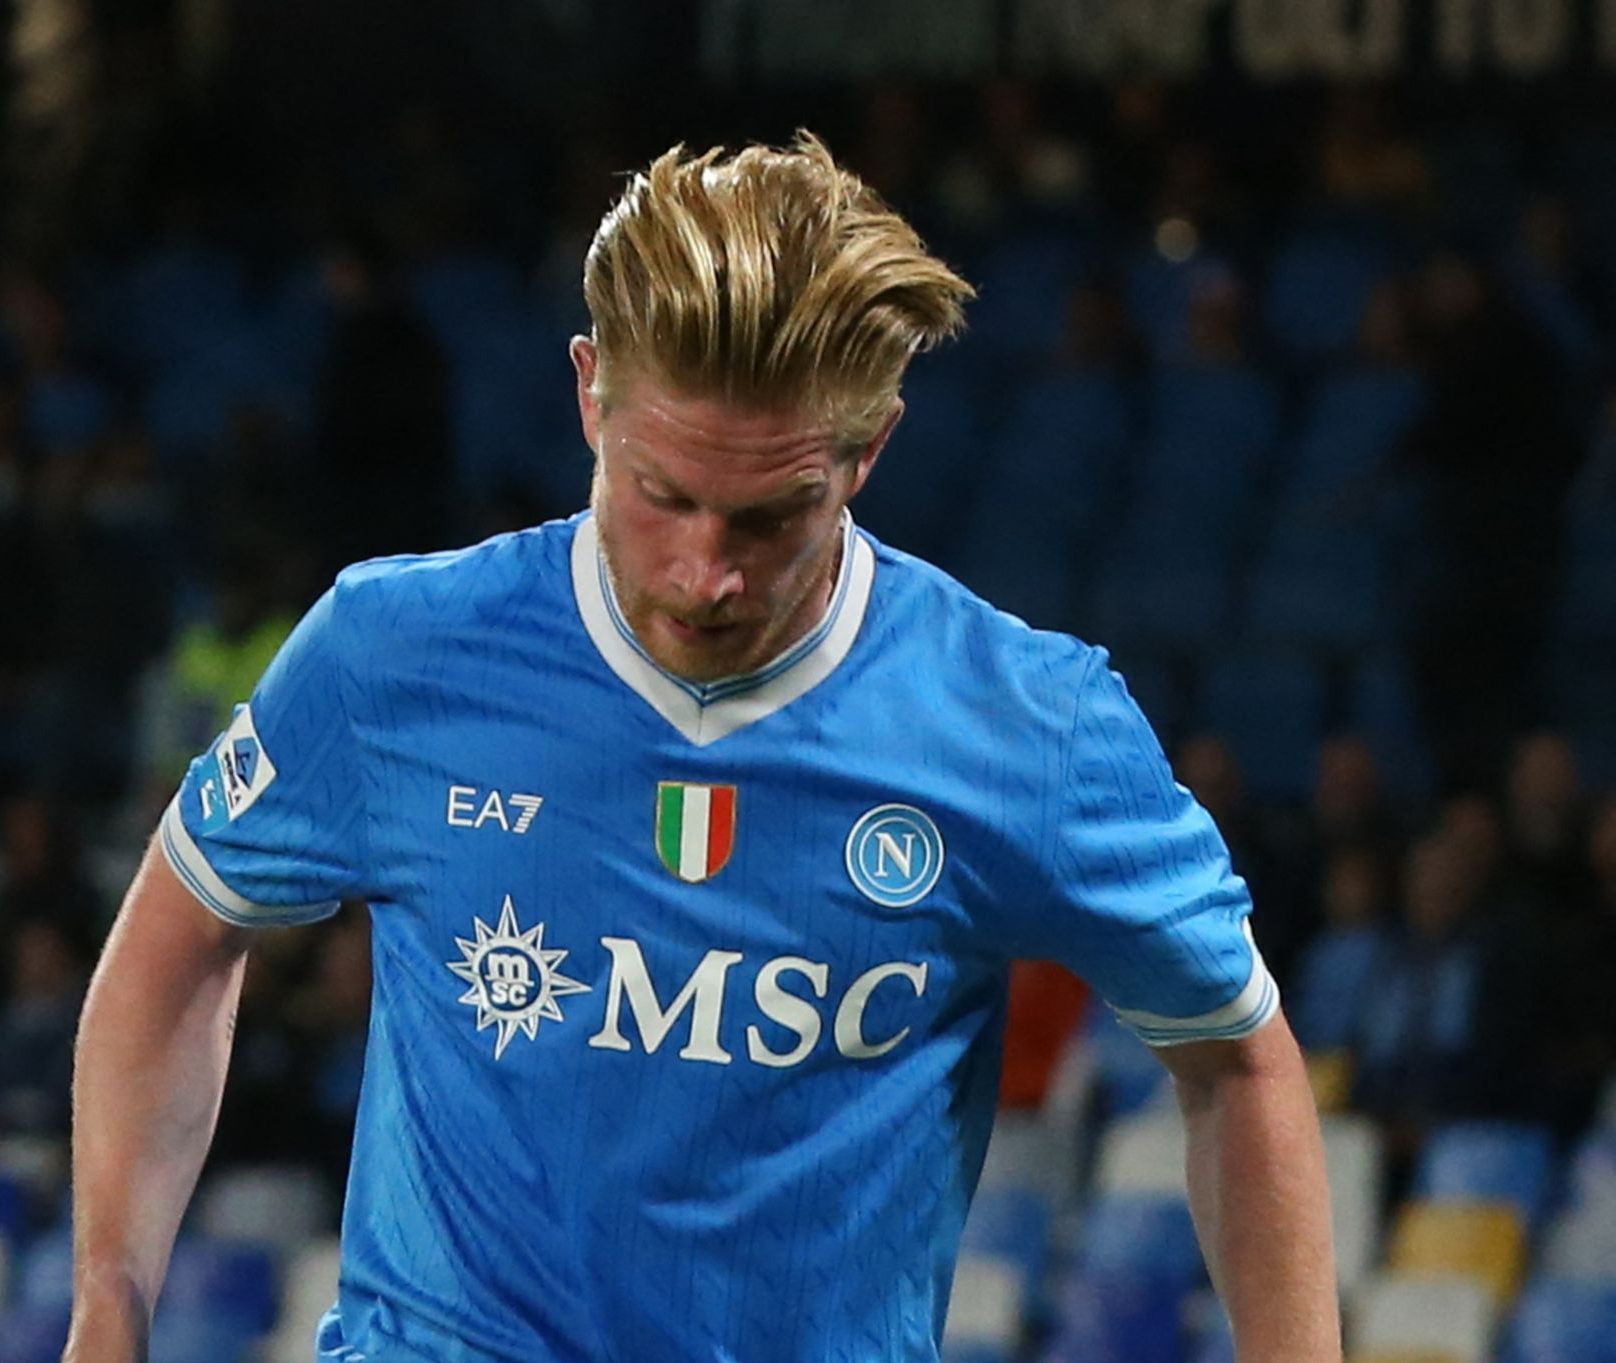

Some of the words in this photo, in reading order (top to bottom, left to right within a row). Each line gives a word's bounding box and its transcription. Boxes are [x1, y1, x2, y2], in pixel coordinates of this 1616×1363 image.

[447, 785, 544, 833] EA7
[874, 832, 916, 879] N
[588, 936, 928, 1067] MSC
